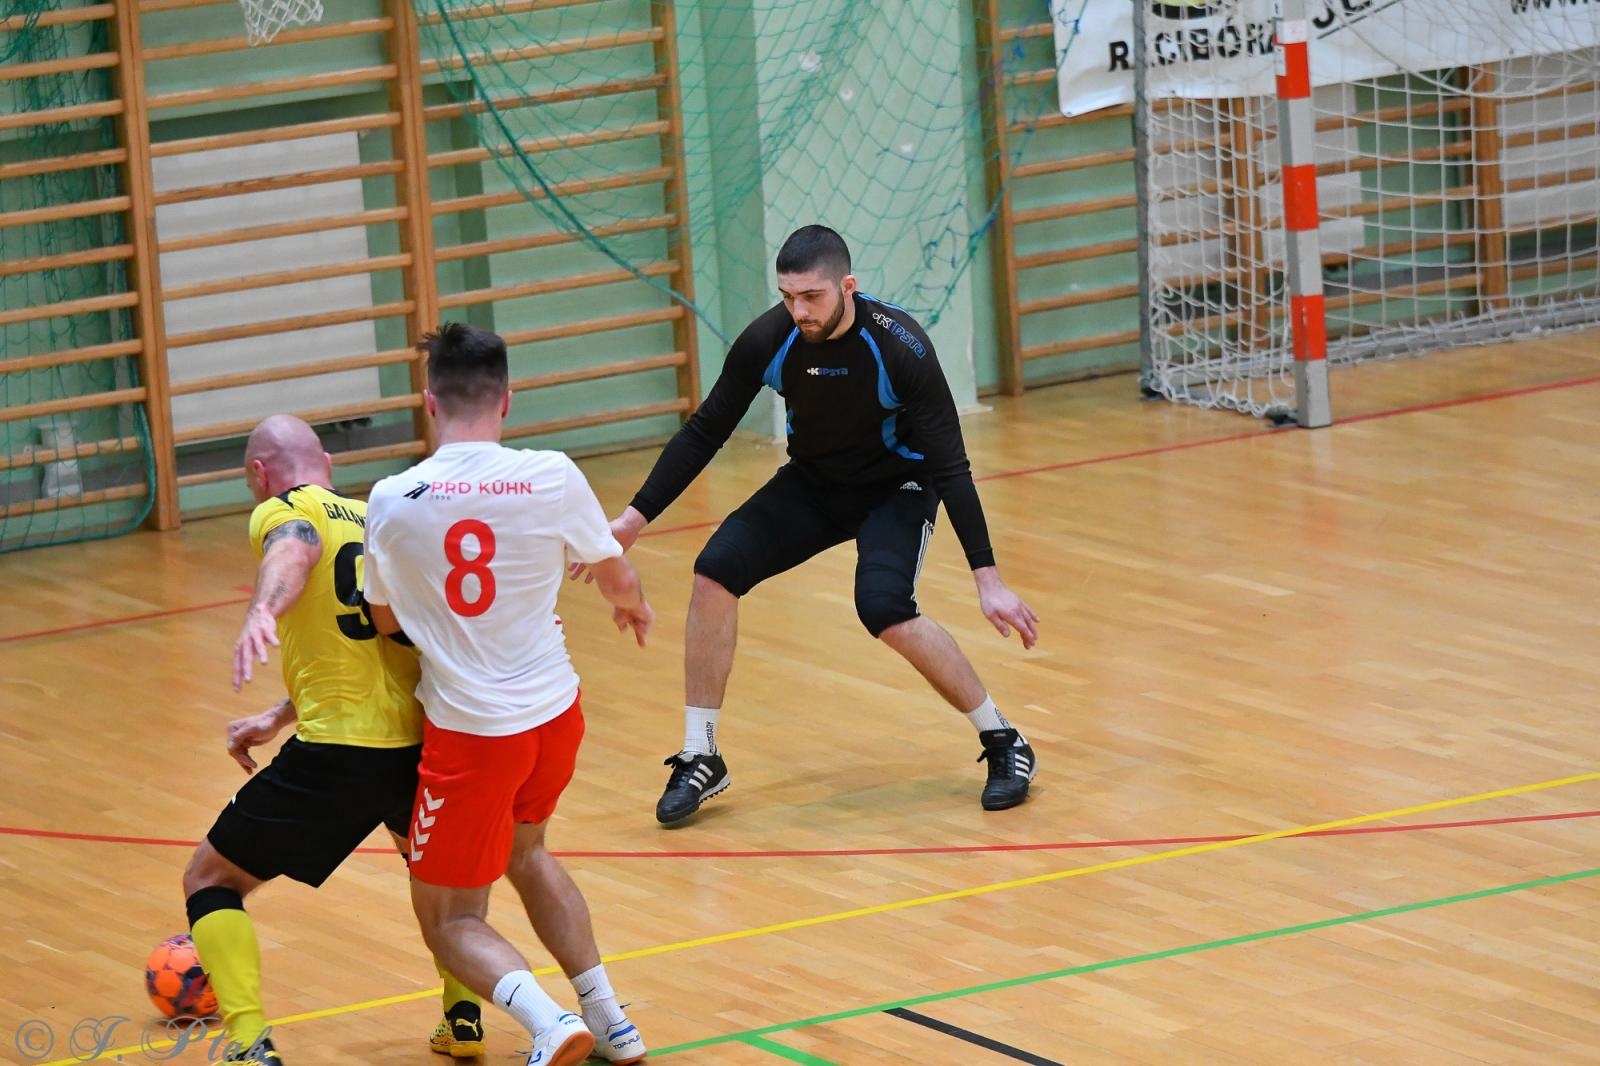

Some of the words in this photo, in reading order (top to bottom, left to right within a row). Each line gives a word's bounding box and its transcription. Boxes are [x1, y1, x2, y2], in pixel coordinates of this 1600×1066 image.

[1108, 17, 1275, 72] RCIBÓR
[431, 481, 472, 494] PRD
[479, 480, 533, 495] KÜHN
[334, 541, 378, 640] 9
[444, 519, 497, 617] 8
